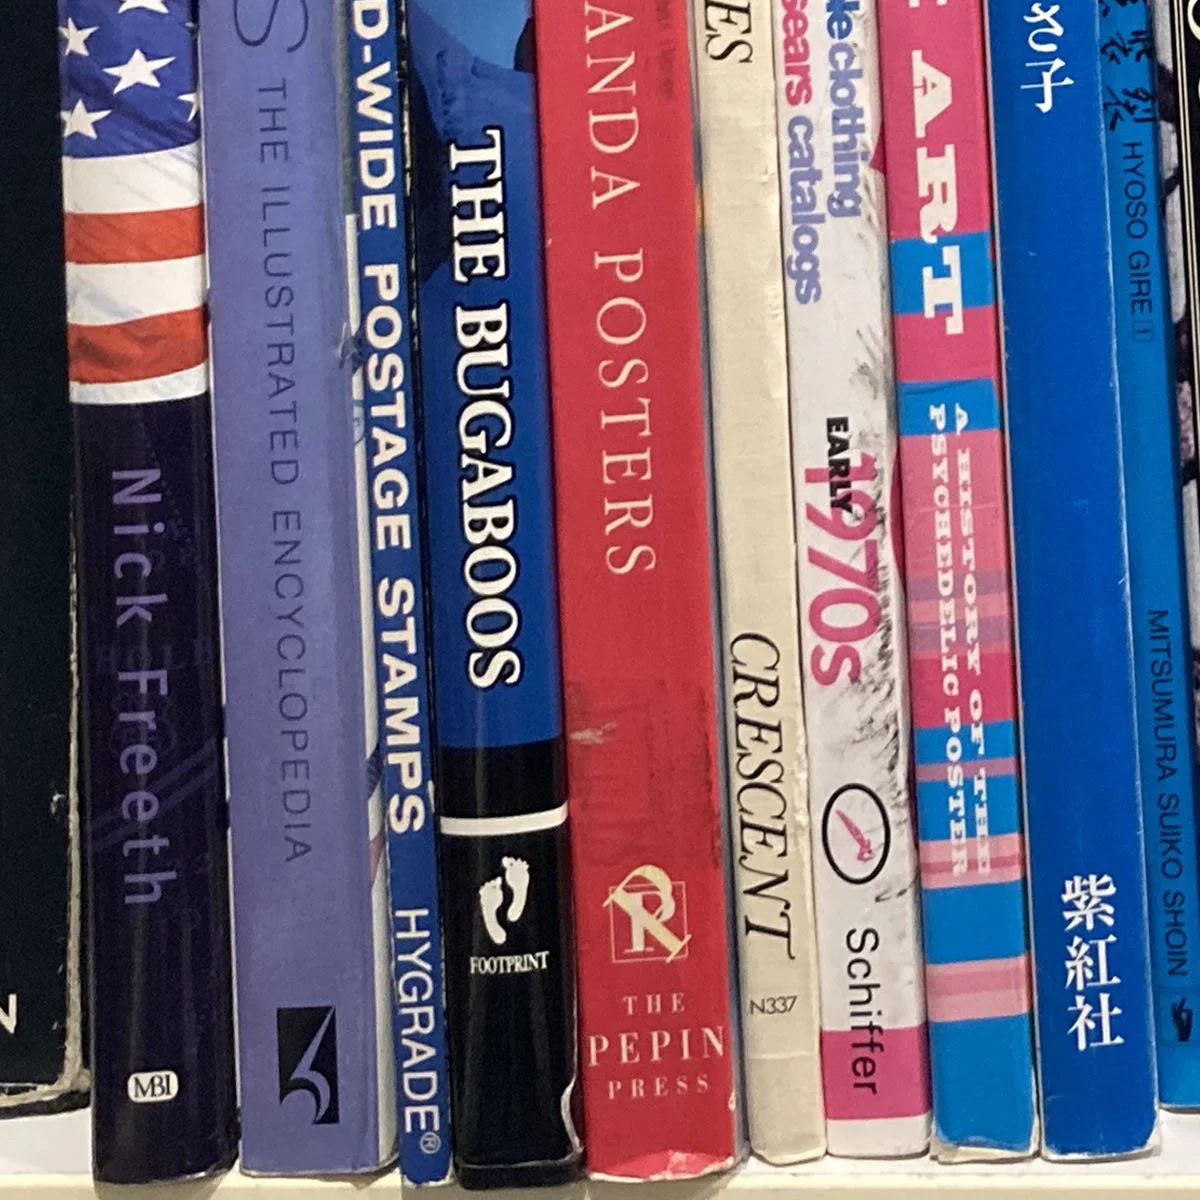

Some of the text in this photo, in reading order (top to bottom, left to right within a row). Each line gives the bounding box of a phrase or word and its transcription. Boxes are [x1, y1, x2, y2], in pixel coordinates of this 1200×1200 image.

[785, 114, 823, 305] catalogs
[823, 40, 866, 220] clothing
[911, 50, 965, 336] ART
[1120, 140, 1147, 240] HYOSO
[1128, 253, 1153, 318] GIRE
[257, 77, 312, 863] THE ILLUSTRATED ENCYCLOPEDIA
[363, 263, 413, 552] POSTAGE
[447, 126, 523, 689] THE BUGABOOS
[594, 247, 657, 575] POSTERS
[803, 415, 884, 687] EARLY 1970s
[928, 403, 970, 878] PSYCHEDELIC POSTER
[954, 403, 991, 874] A HISTORY OF THE
[110, 467, 180, 905] Nick Freeth
[378, 577, 426, 835] STAMPS
[728, 631, 797, 962] CRESCENT
[1146, 608, 1188, 977] MITSUMURA SUIKO SHOIN
[469, 952, 549, 975] FOOTPRINT
[587, 1025, 728, 1068] PEPIN
[622, 992, 685, 1017] THE
[749, 996, 798, 1018] N337
[845, 927, 886, 1095] Schiffer
[1060, 873, 1124, 1052] 紫紅社
[133, 1075, 174, 1099] MBI
[608, 1073, 710, 1100] PRESS
